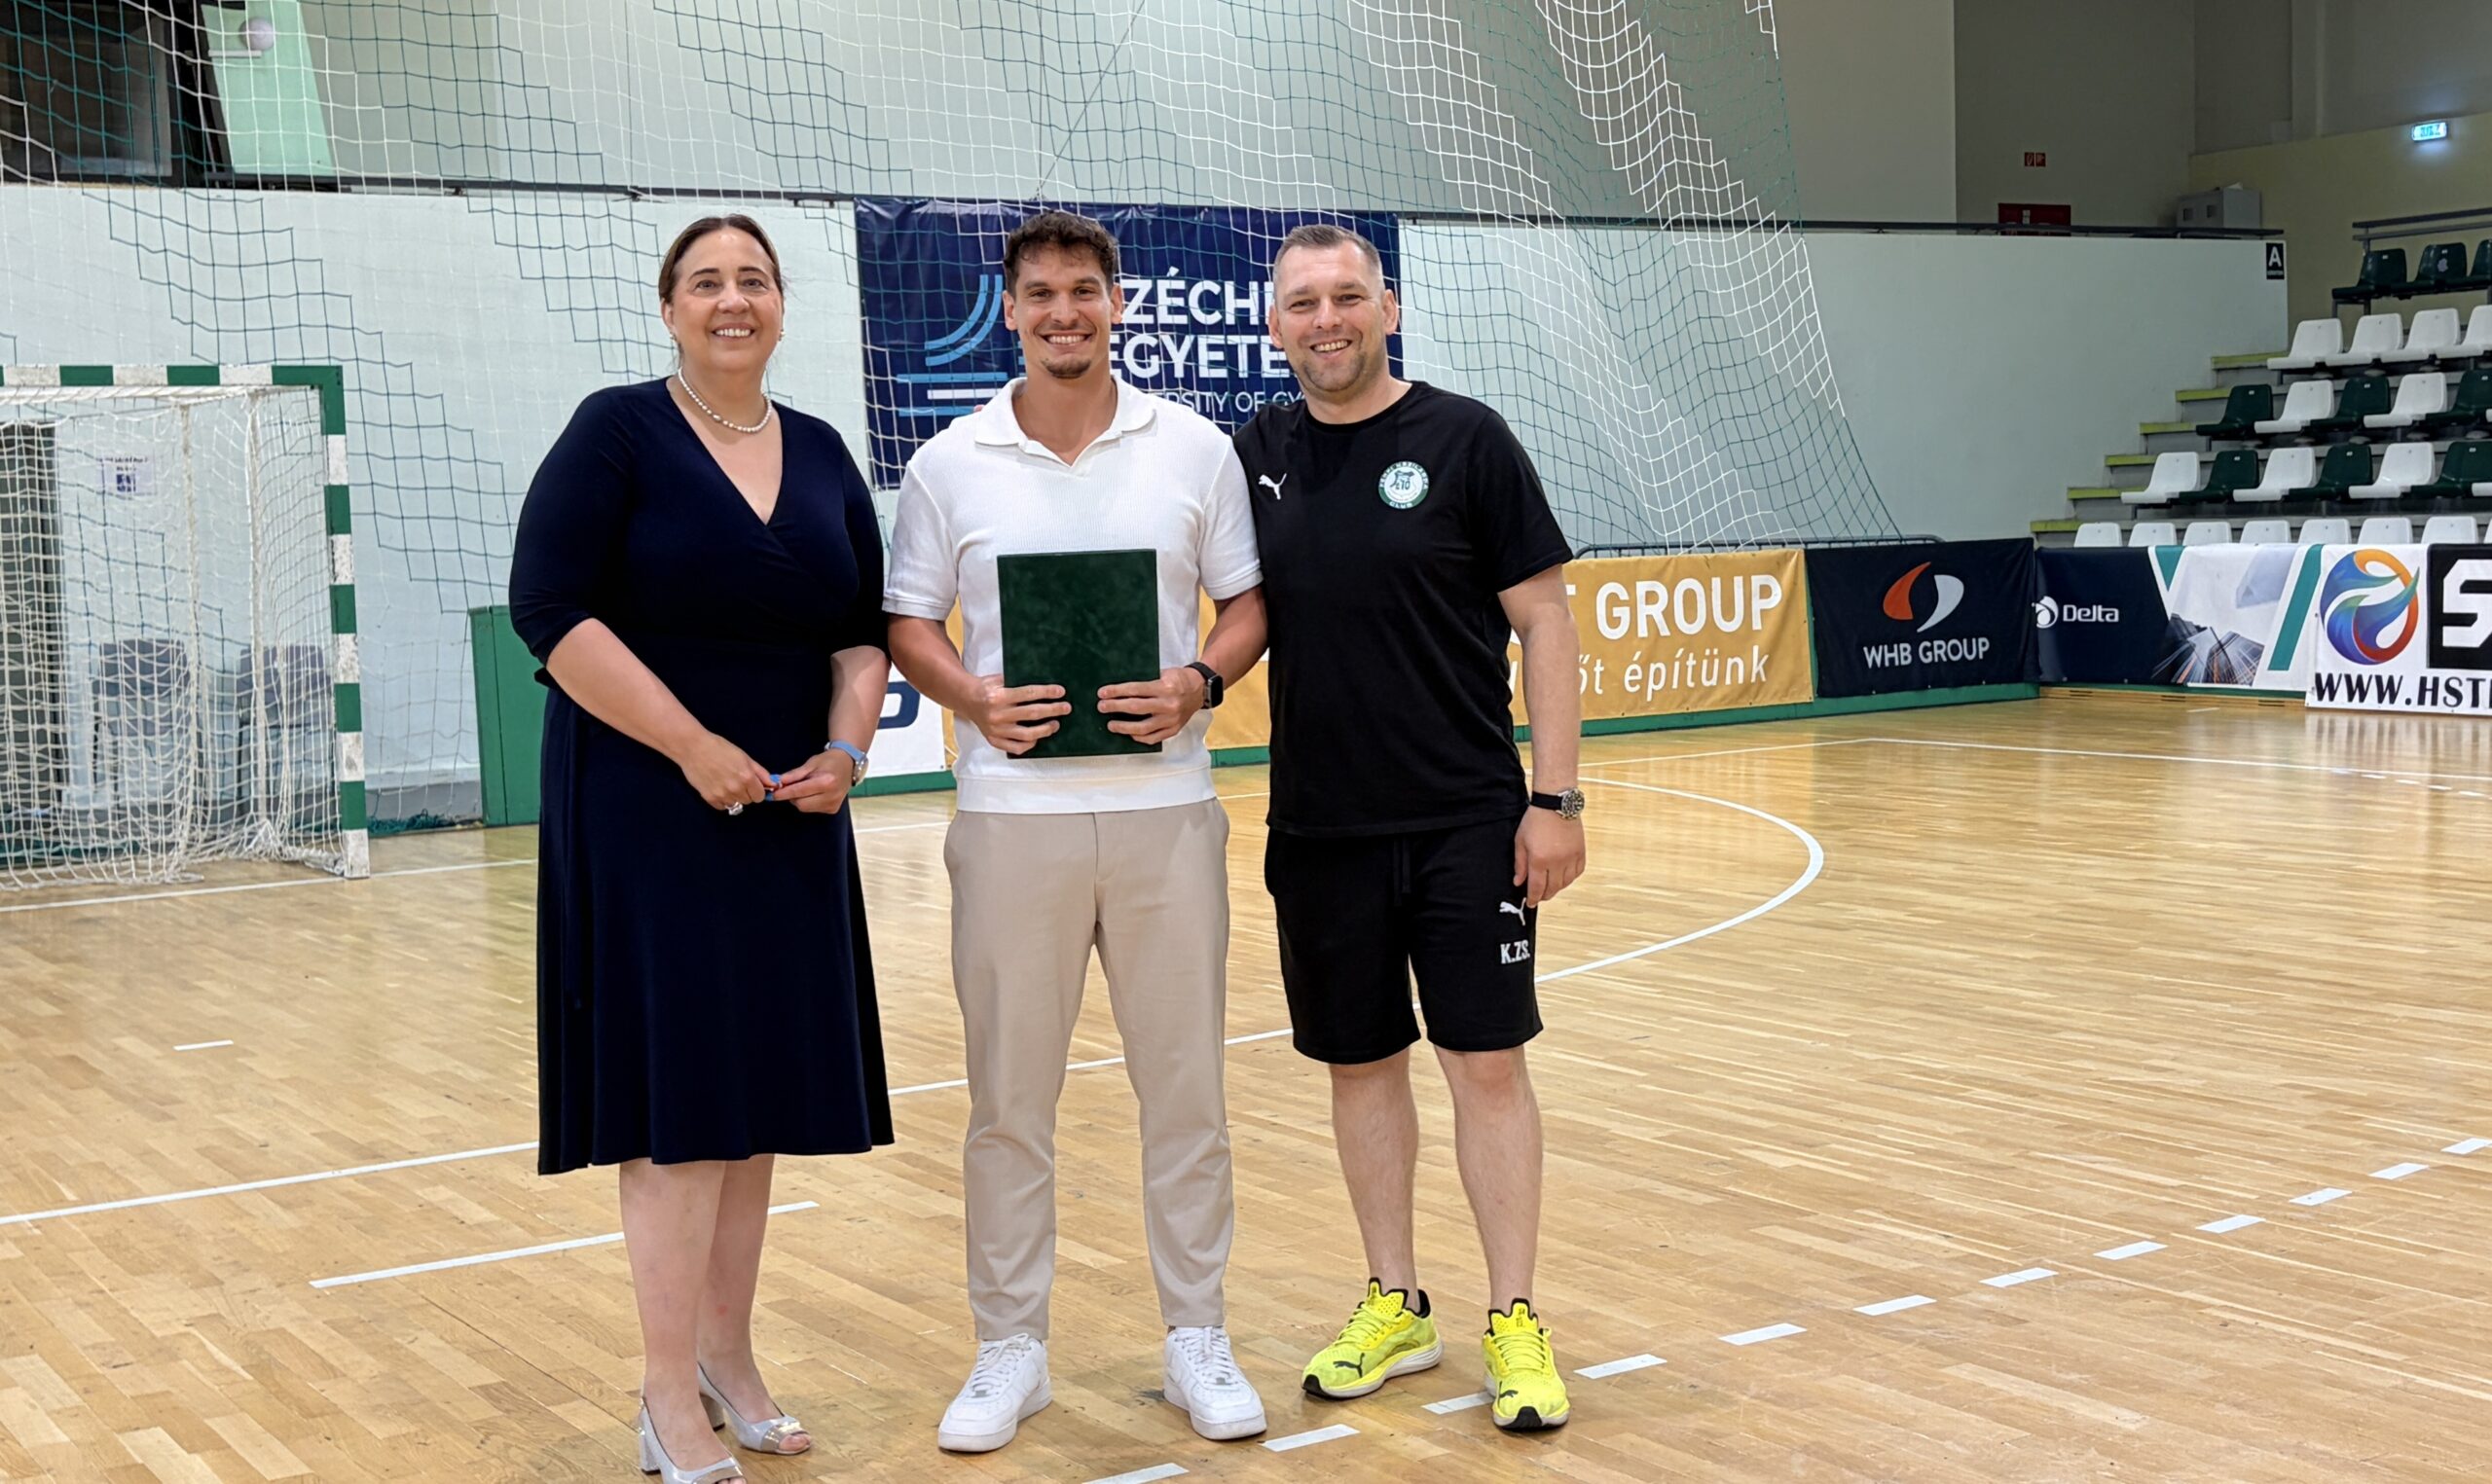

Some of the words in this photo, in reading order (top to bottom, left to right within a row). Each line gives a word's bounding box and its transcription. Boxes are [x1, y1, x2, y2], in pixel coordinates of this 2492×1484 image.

[2269, 246, 2282, 267] A
[1119, 266, 1274, 325] ZÉCH
[1596, 574, 1782, 640] GROUP
[2063, 604, 2119, 622] Delta
[1863, 642, 1912, 669] WHB
[1919, 637, 1990, 664] GROUP
[1624, 645, 1769, 702] építünk
[2315, 672, 2492, 708] WWW.HST
